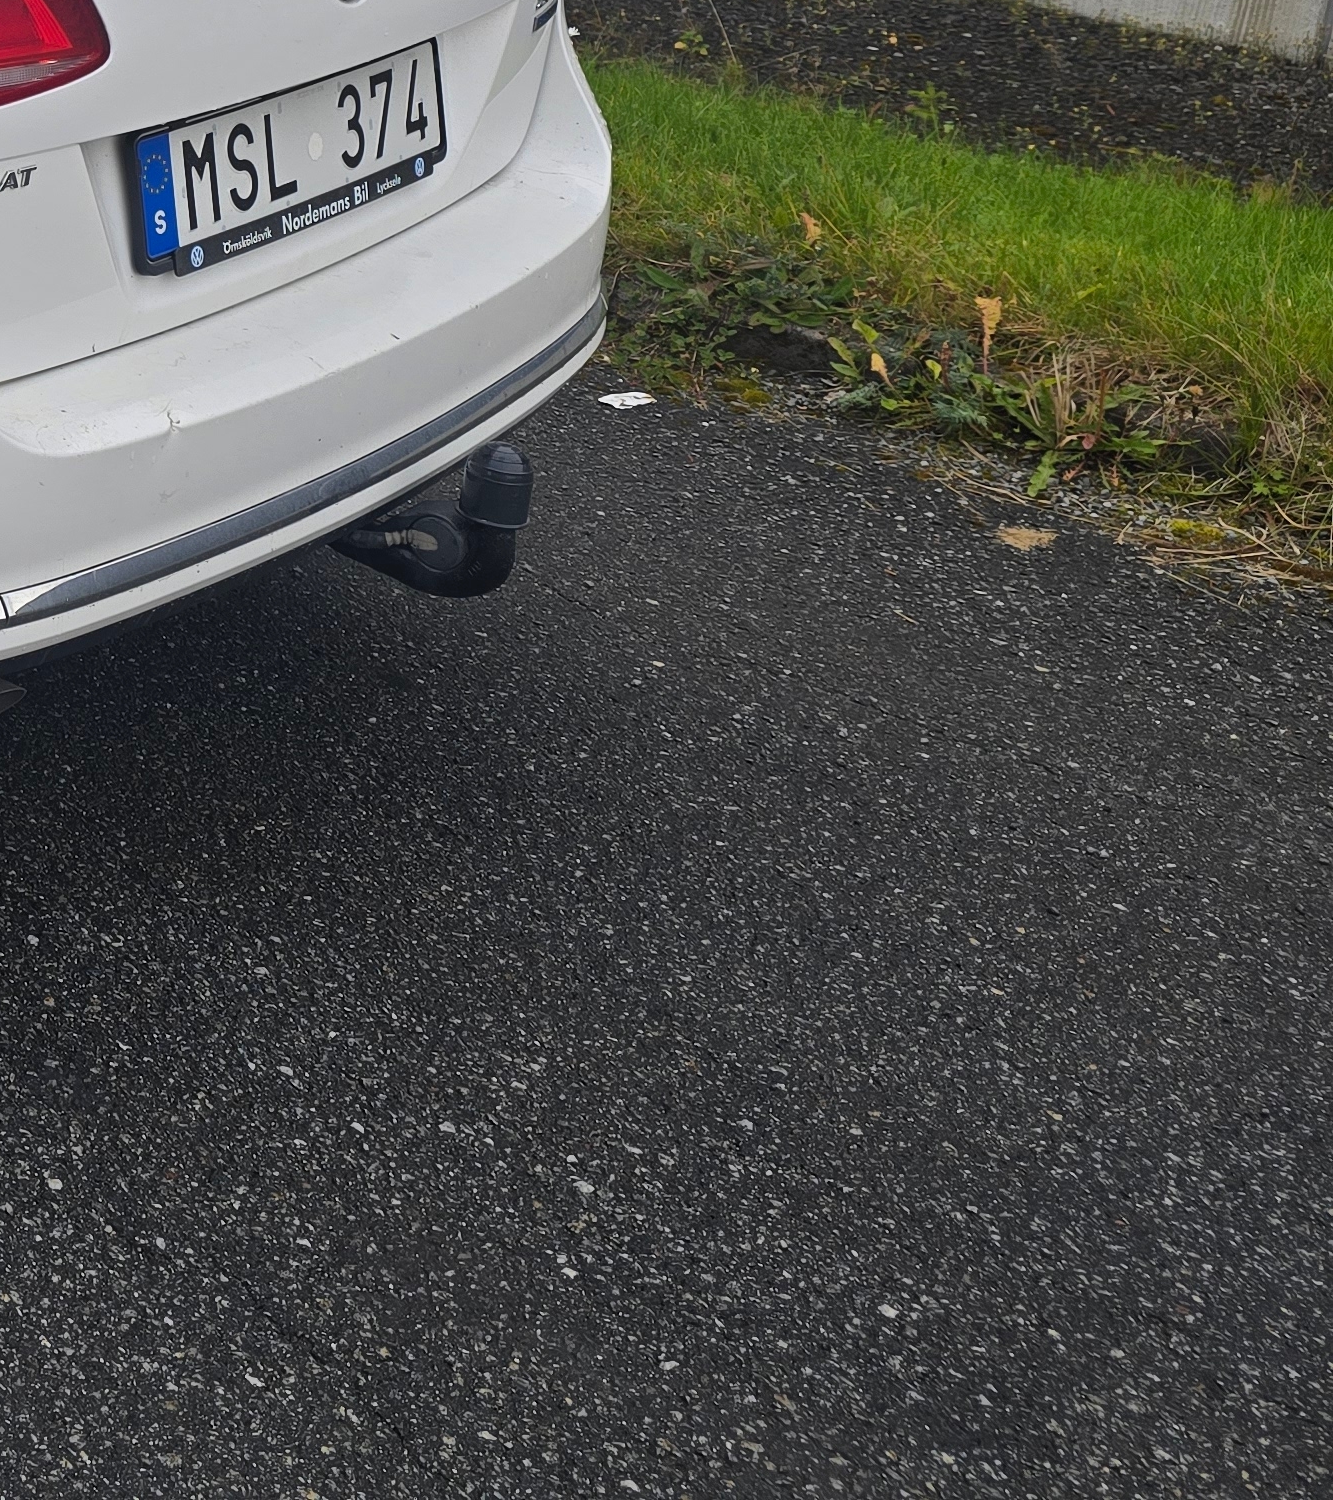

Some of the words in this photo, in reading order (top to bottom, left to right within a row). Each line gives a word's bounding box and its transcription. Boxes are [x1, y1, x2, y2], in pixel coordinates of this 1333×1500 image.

[181, 113, 299, 232] MSL
[337, 58, 429, 169] 374
[154, 209, 167, 235] S
[281, 196, 351, 235] Nordemans
[353, 181, 369, 205] Bil
